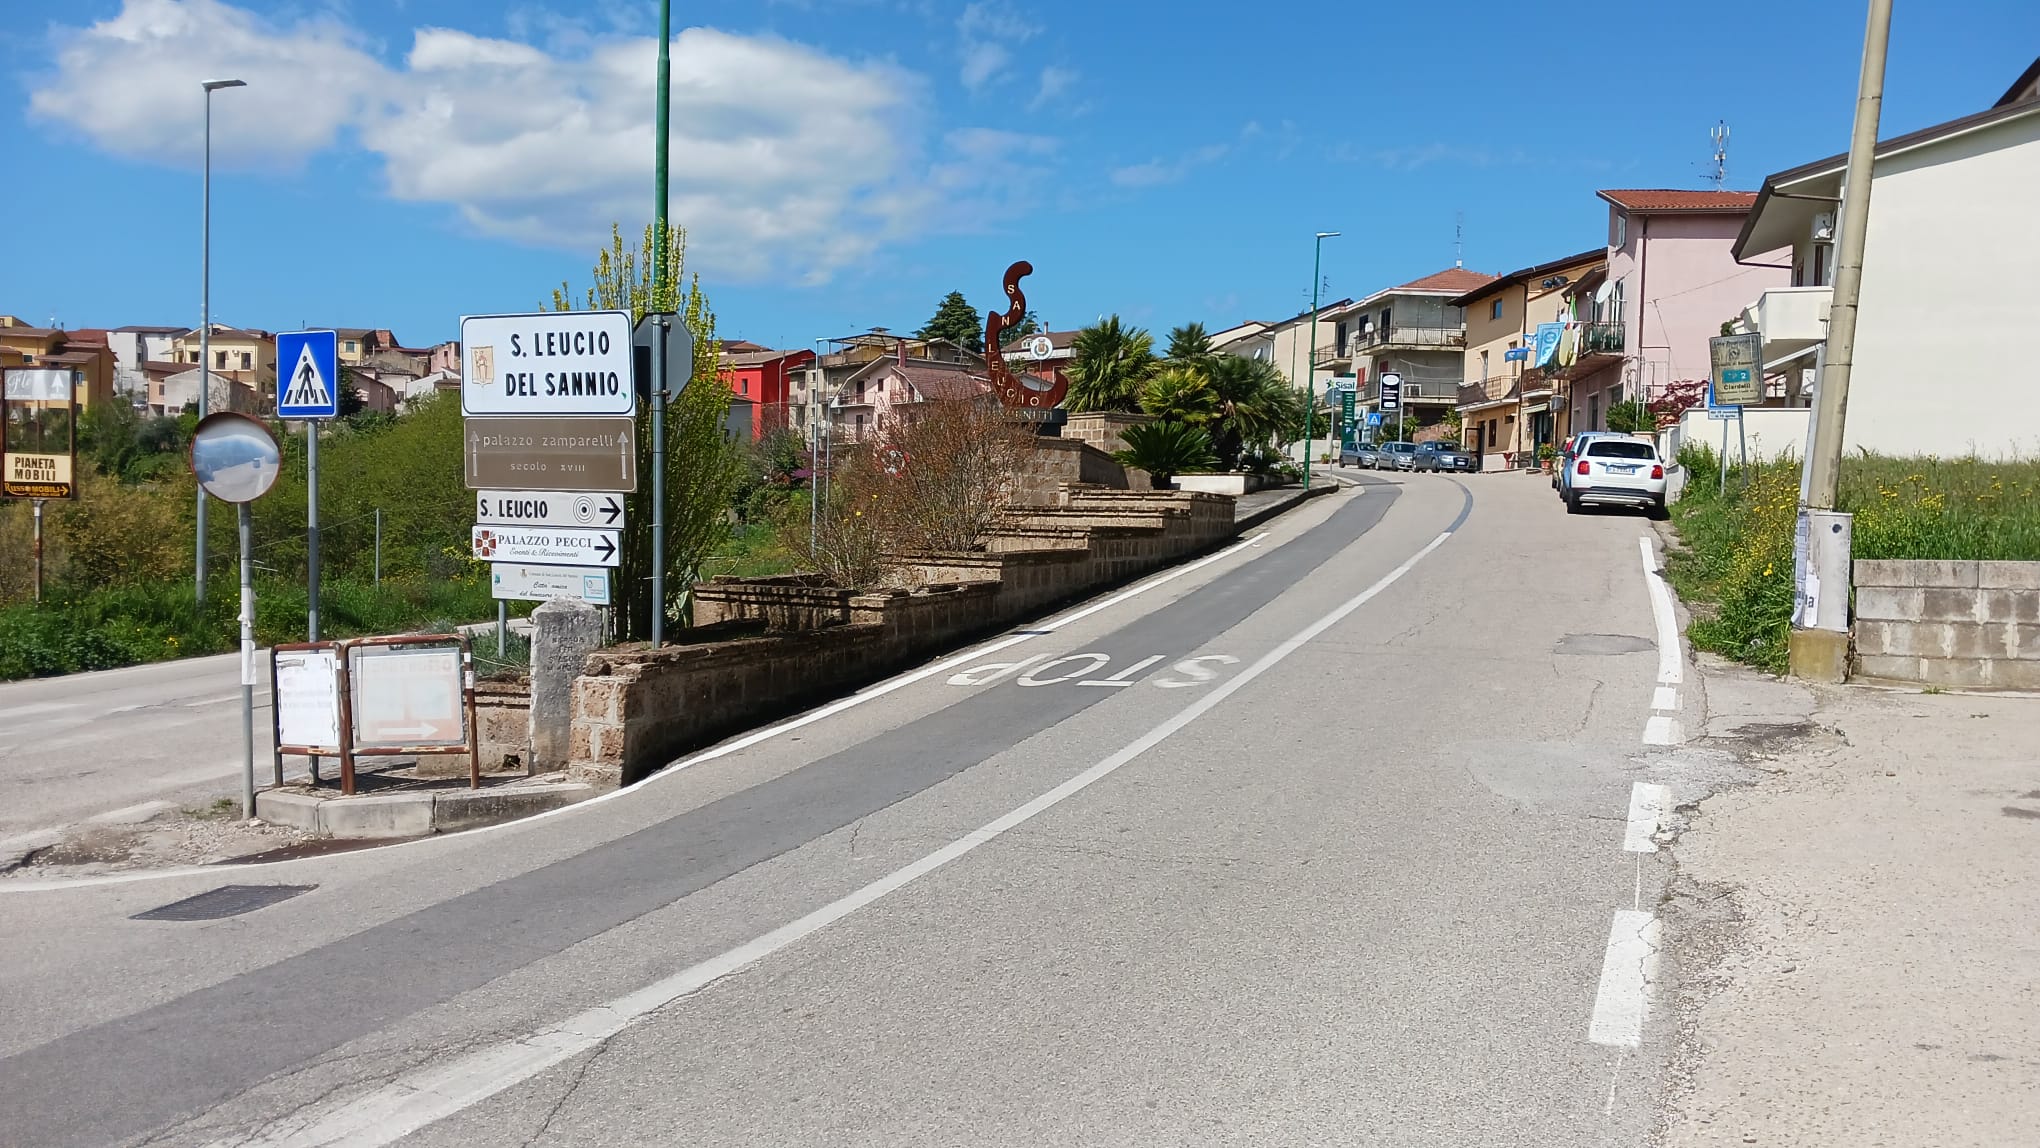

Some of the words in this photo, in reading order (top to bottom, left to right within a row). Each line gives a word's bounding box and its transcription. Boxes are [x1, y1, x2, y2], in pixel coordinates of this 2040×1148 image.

[1001, 284, 1021, 326] SAN
[510, 333, 528, 358] S.
[534, 331, 610, 356] LEUCIO
[988, 343, 1040, 407] LEUCIO
[505, 373, 537, 397] DEL
[545, 371, 619, 396] SANNIO
[1335, 381, 1355, 390] Sisal
[483, 433, 533, 448] palazzo
[542, 433, 614, 449] zamparelli
[14, 456, 56, 470] PIANETA
[510, 462, 547, 472] secolo
[14, 468, 56, 482] MOBILI
[480, 499, 493, 517] S.
[499, 499, 548, 518] LEUCIO
[497, 534, 550, 547] PALAZZO
[555, 536, 592, 547] PECCI
[945, 652, 1242, 688] STOP
